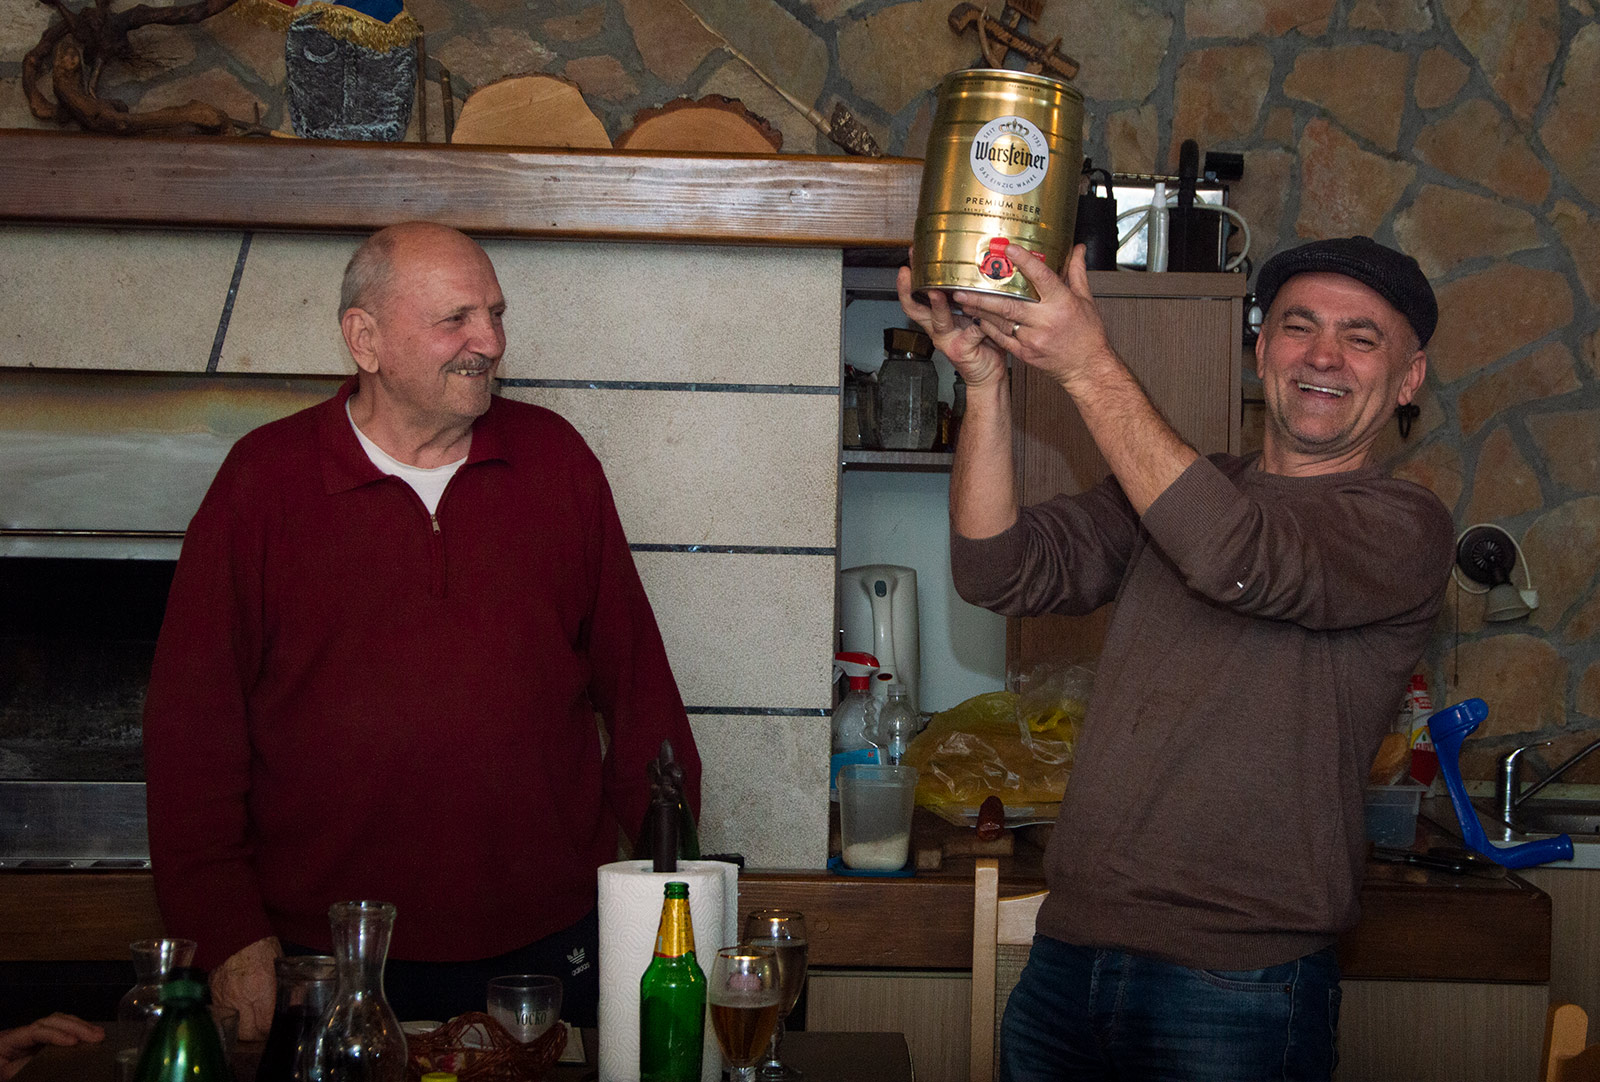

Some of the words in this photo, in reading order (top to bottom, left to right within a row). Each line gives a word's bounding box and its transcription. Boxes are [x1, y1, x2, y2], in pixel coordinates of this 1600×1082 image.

[984, 127, 996, 139] SEIT
[975, 141, 1046, 170] Warsteiner
[979, 166, 989, 179] DAS
[990, 177, 1014, 189] EINZIG
[1016, 174, 1037, 188] WAHRE
[965, 197, 1014, 209] PREMIUM
[1017, 203, 1040, 216] BEER
[571, 961, 591, 976] adidas
